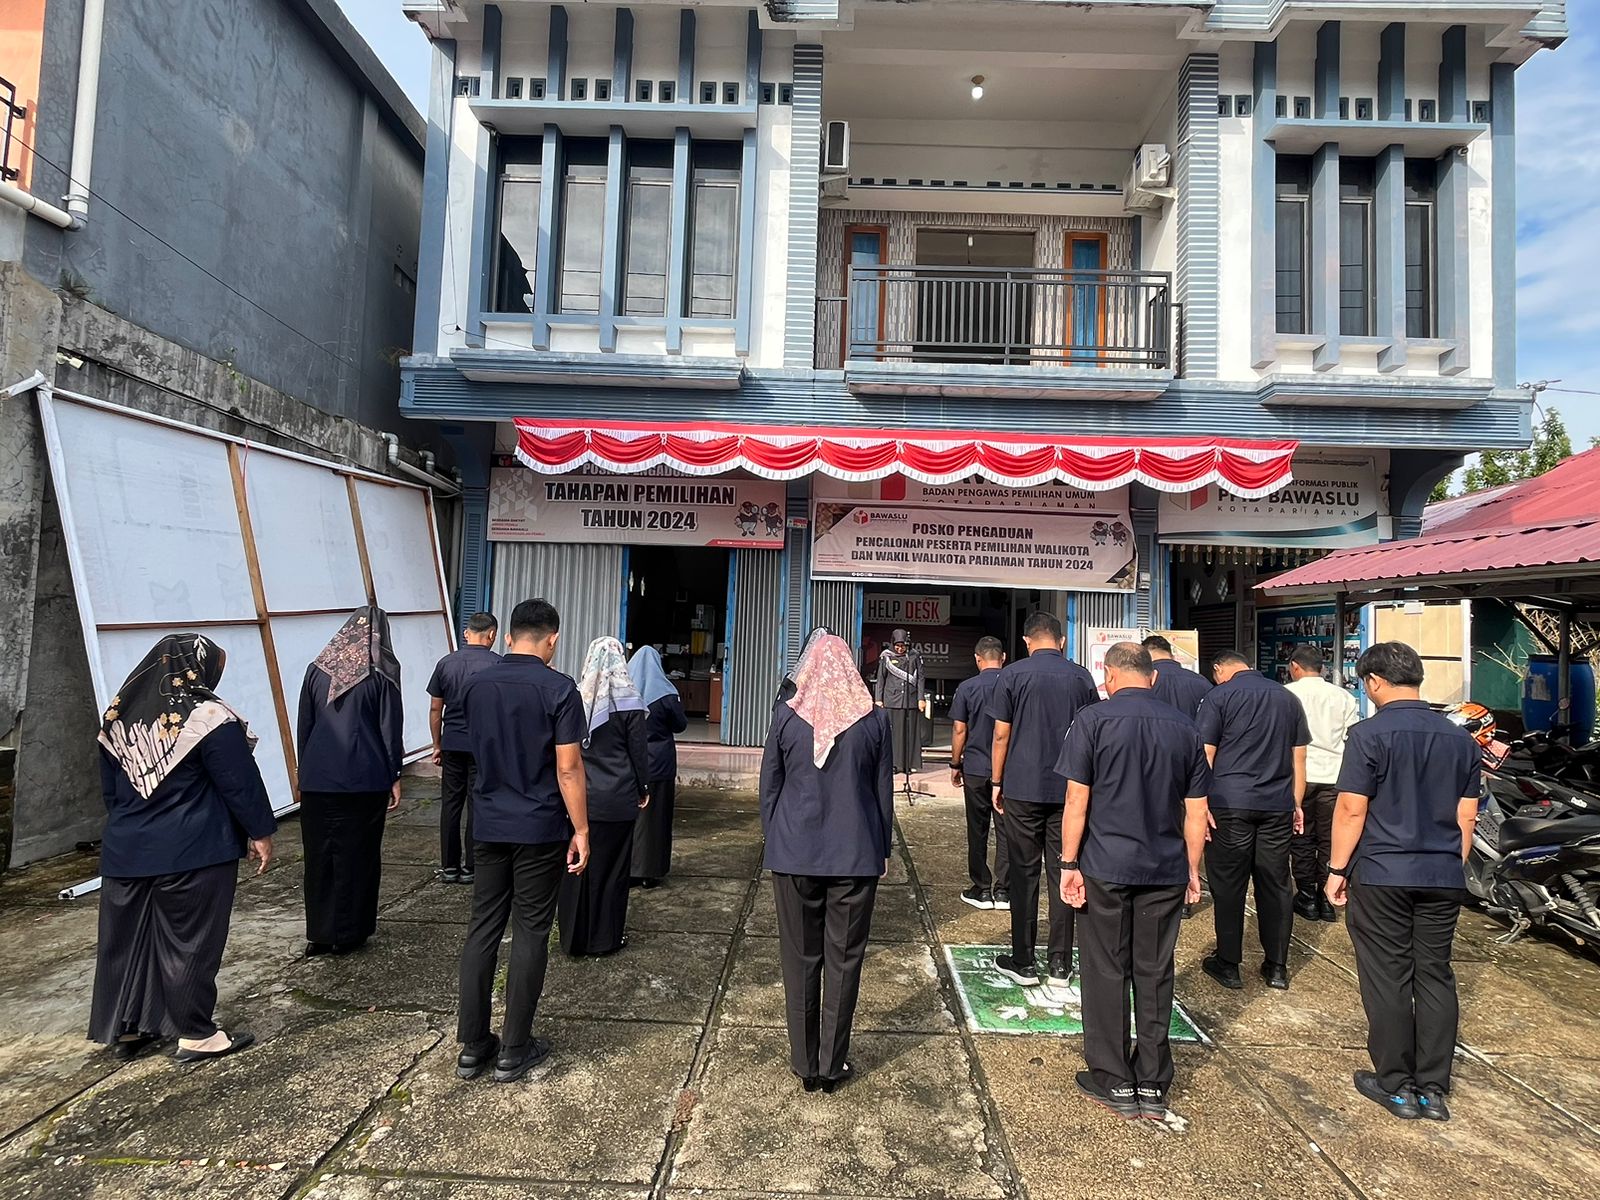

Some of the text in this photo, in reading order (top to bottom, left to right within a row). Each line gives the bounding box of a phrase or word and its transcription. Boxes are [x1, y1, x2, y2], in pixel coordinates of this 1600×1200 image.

[1288, 480, 1358, 488] NFORMASI PUBLIK
[544, 482, 735, 505] TAHAPAN PEMILIHAN
[922, 487, 1096, 499] BADAN PENGAWAS PEMILIHAN UMUM
[1268, 490, 1359, 506] BAWASLU
[581, 509, 697, 530] TAHUN 2024
[870, 512, 908, 520] BAWASLU
[1268, 506, 1359, 517] PARIAMAN
[912, 523, 1034, 540] POSKO PENGADUAN
[856, 536, 1090, 556] PENCALONAN PESERTA PEMILIHAN WALIKOTA
[851, 550, 873, 561] DAN
[875, 551, 910, 562] WAKIL
[912, 552, 966, 565] WALIKOTA
[968, 555, 1025, 567] PARIAMAN
[1027, 557, 1063, 569] TAHUN
[1065, 559, 1094, 570] 2024
[868, 600, 940, 620] HELP DESK
